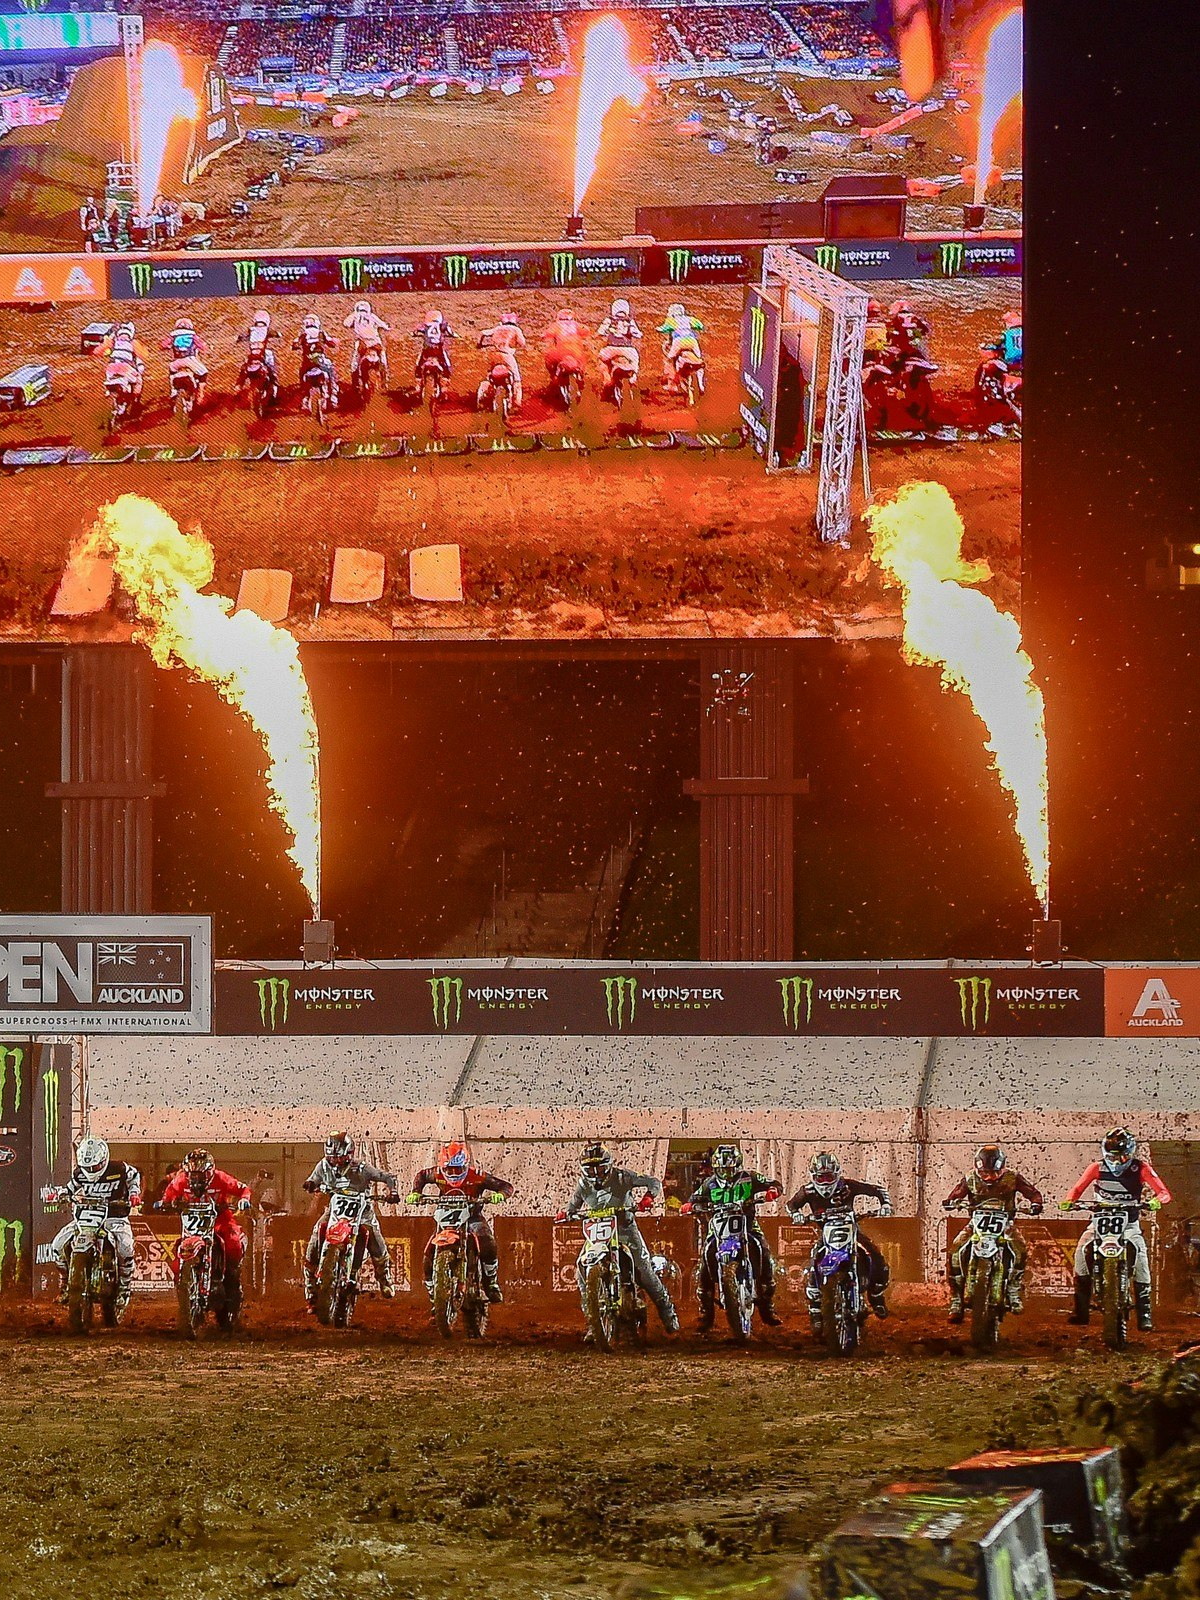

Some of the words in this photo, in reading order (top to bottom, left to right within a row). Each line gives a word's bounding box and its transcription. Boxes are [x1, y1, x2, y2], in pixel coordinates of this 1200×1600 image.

[98, 988, 184, 1004] AUCKLAND
[295, 987, 375, 1002] MONSTER
[468, 987, 548, 1002] MONSTER
[643, 987, 725, 1002] MONSTER
[818, 987, 901, 1002] MONSTER
[997, 987, 1080, 1002] MONSTER
[0, 1017, 68, 1026] SUPERCROSS
[80, 1018, 102, 1026] FMX
[107, 1018, 192, 1026] INTERNATIONAL
[1128, 1019, 1184, 1027] AUCKLAND
[82, 1181, 120, 1192] THOR
[335, 1200, 359, 1217] 38
[79, 1210, 104, 1227] 5
[440, 1210, 463, 1225] 4
[977, 1217, 1004, 1233] 45
[586, 1221, 611, 1241] 15
[717, 1216, 742, 1235] 70
[1098, 1216, 1124, 1235] 88
[829, 1227, 850, 1243] 6
